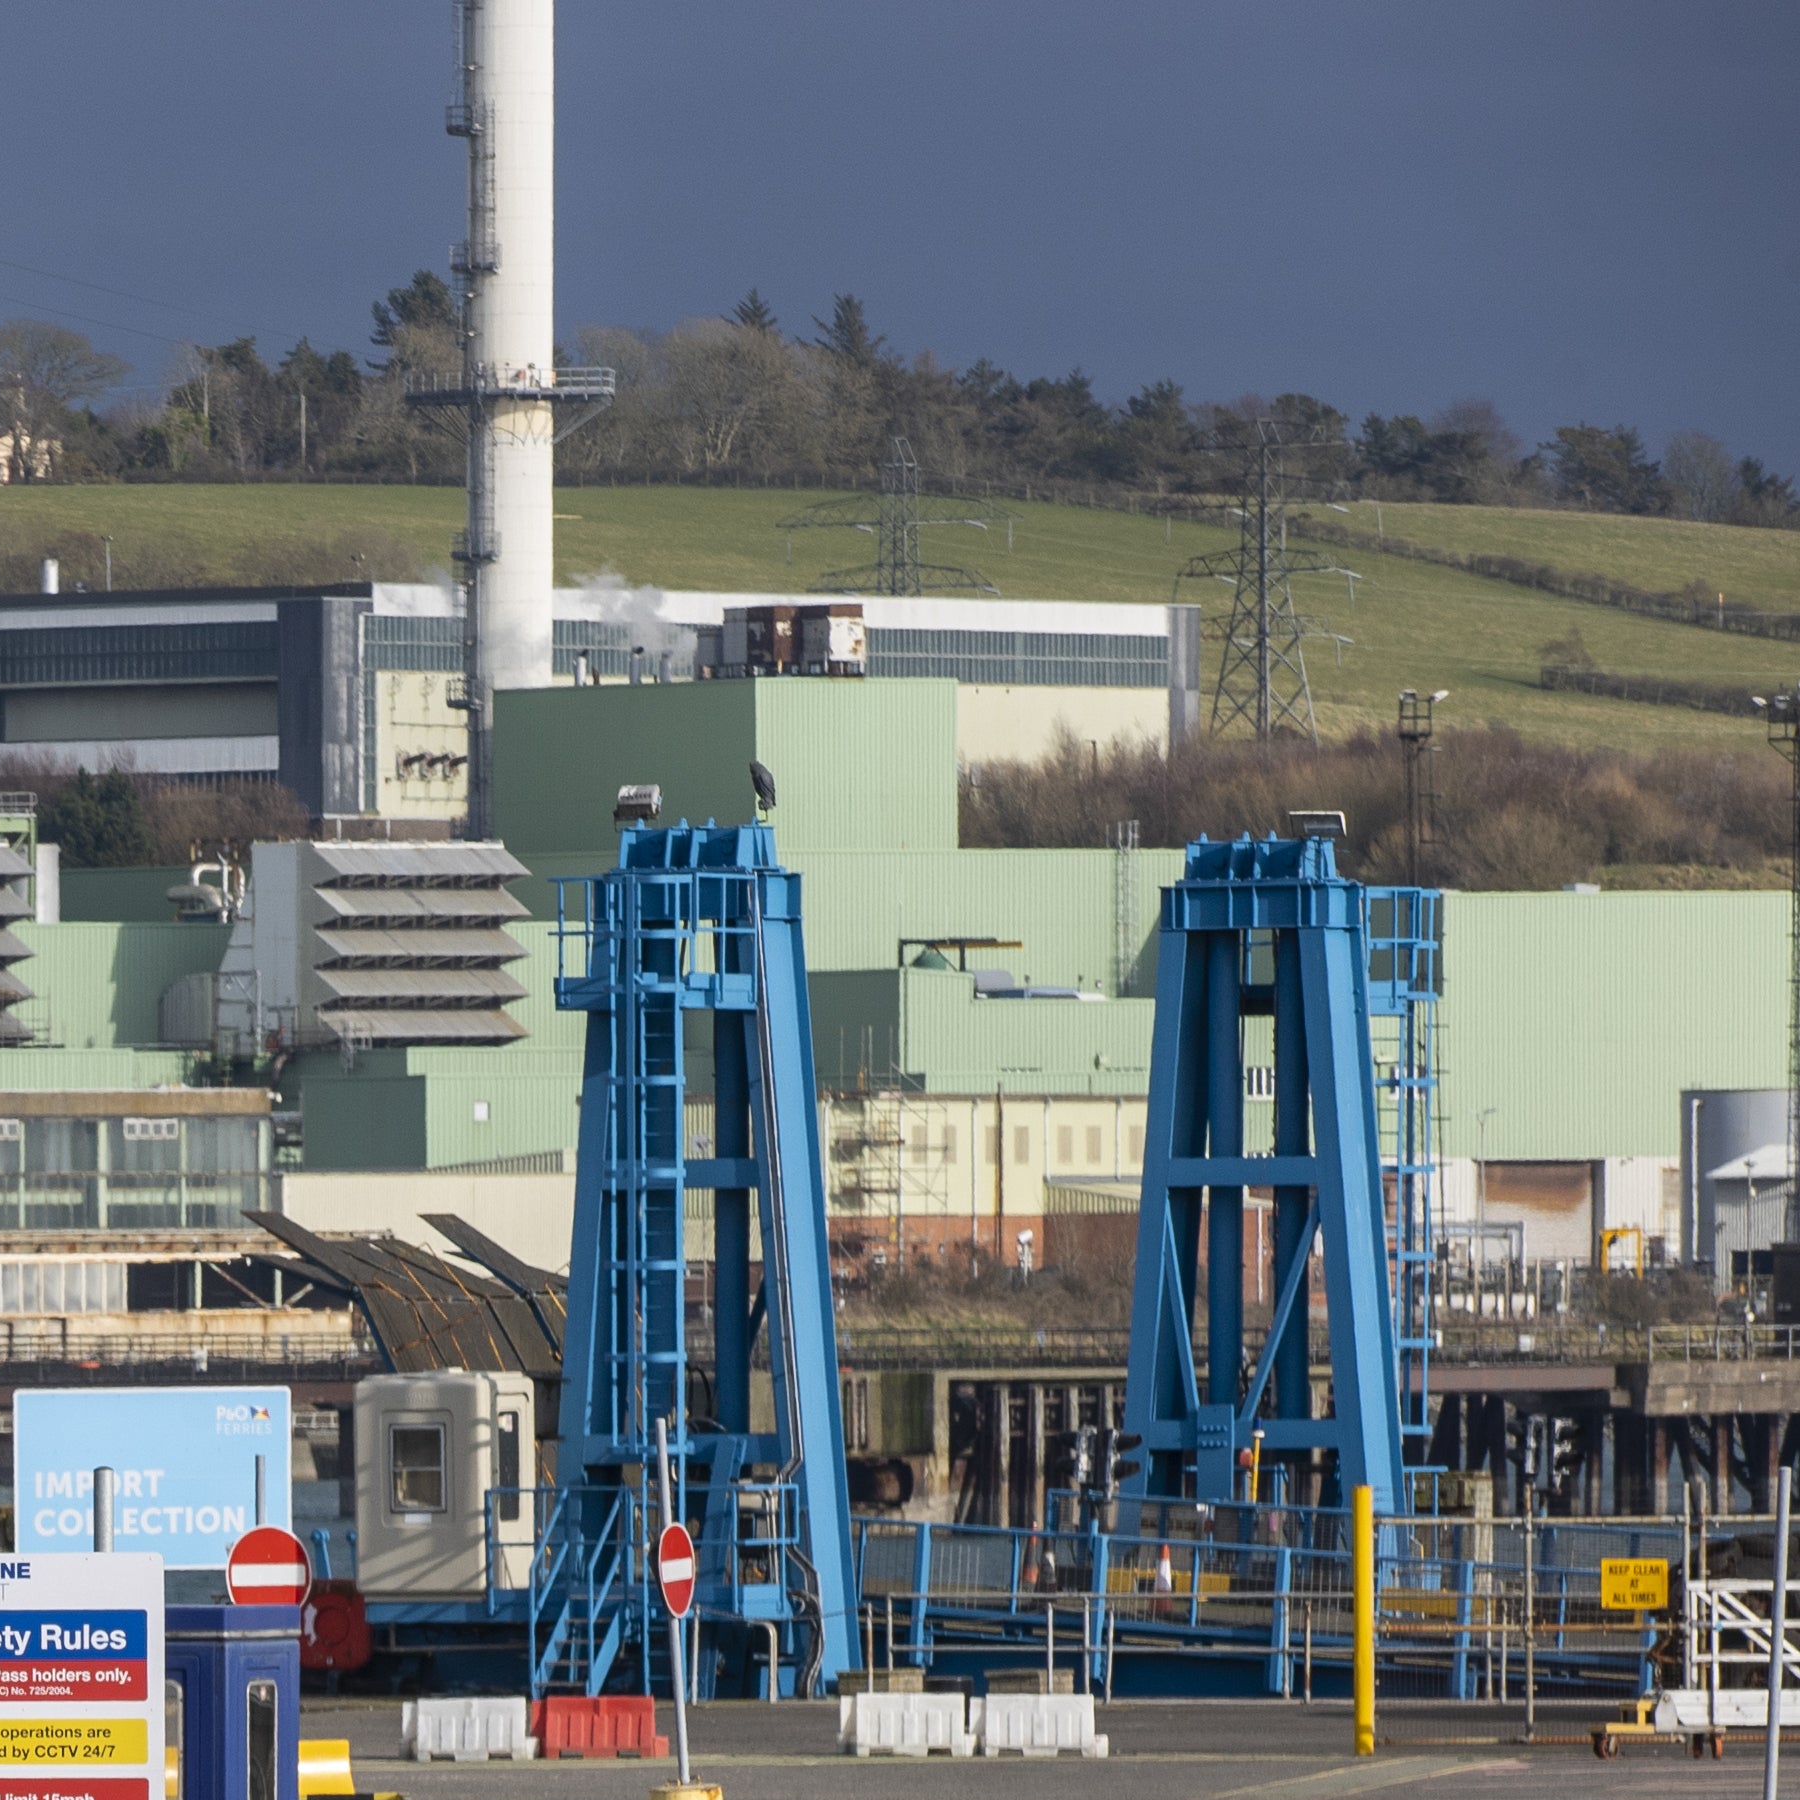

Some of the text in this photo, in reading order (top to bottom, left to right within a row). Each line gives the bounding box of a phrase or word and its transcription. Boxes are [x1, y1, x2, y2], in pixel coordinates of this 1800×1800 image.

[216, 1423, 272, 1434] FERRIES
[34, 1470, 165, 1499] IMPRT
[1609, 1565, 1660, 1576] KEEP CLEAR
[1630, 1579, 1639, 1588] AT
[1613, 1593, 1656, 1603] ALL TIMES
[40, 1624, 127, 1650] Rules
[32, 1668, 91, 1682] holders
[95, 1667, 132, 1685] only.
[10, 1686, 27, 1696] No.
[29, 1686, 73, 1696] 725/2004.
[0, 1725, 82, 1742] operations
[87, 1728, 111, 1738] are
[12, 1745, 30, 1761] by
[34, 1745, 78, 1758] CCTV
[83, 1744, 116, 1758] 24/7
